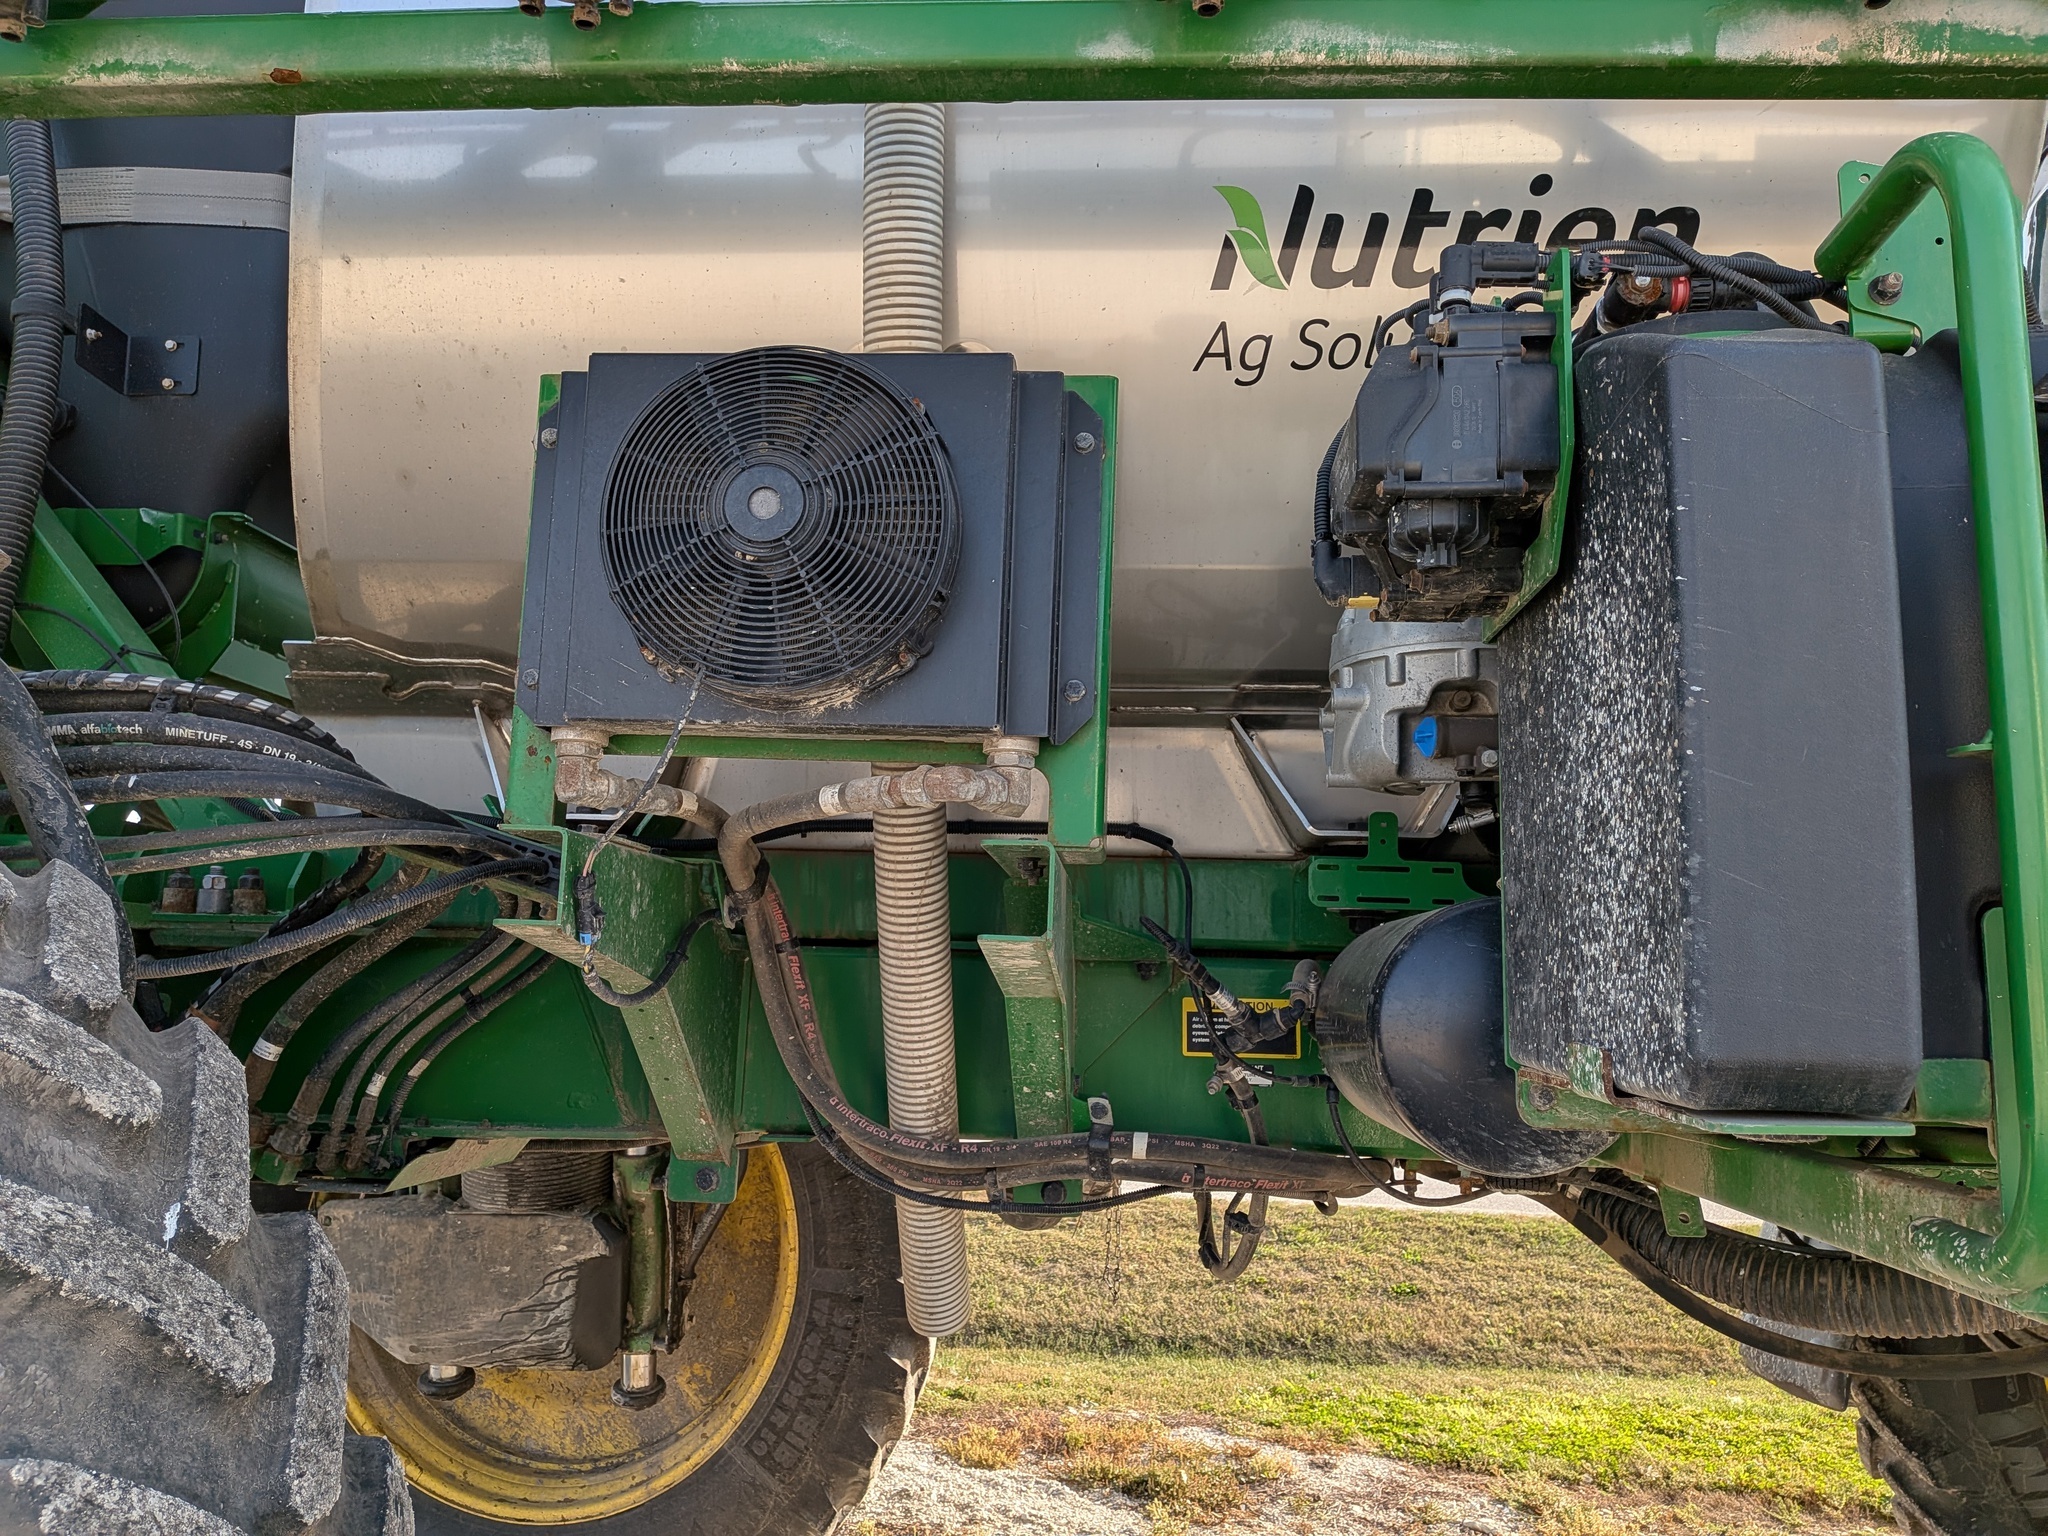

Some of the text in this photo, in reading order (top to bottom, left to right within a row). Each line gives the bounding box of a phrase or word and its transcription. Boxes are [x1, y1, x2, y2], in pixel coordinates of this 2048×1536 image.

[1192, 315, 1393, 387] Ag Sol
[80, 723, 142, 735] alfabiotech
[165, 727, 228, 744] MINETUFF
[237, 739, 253, 750] 4S
[263, 745, 281, 757] DN
[284, 752, 297, 761] 19
[788, 955, 806, 990] Flexit
[798, 993, 811, 1010] XF
[804, 1022, 817, 1041] R4
[890, 1133, 927, 1150] Flexit
[928, 1142, 949, 1153] XF
[960, 1143, 978, 1153] R4
[1174, 1140, 1196, 1148] MSHA
[1201, 1142, 1220, 1150] 3Q22
[946, 1179, 963, 1187] 2Q22
[1203, 1176, 1251, 1189] tertraco
[1254, 1179, 1289, 1190] Flexit
